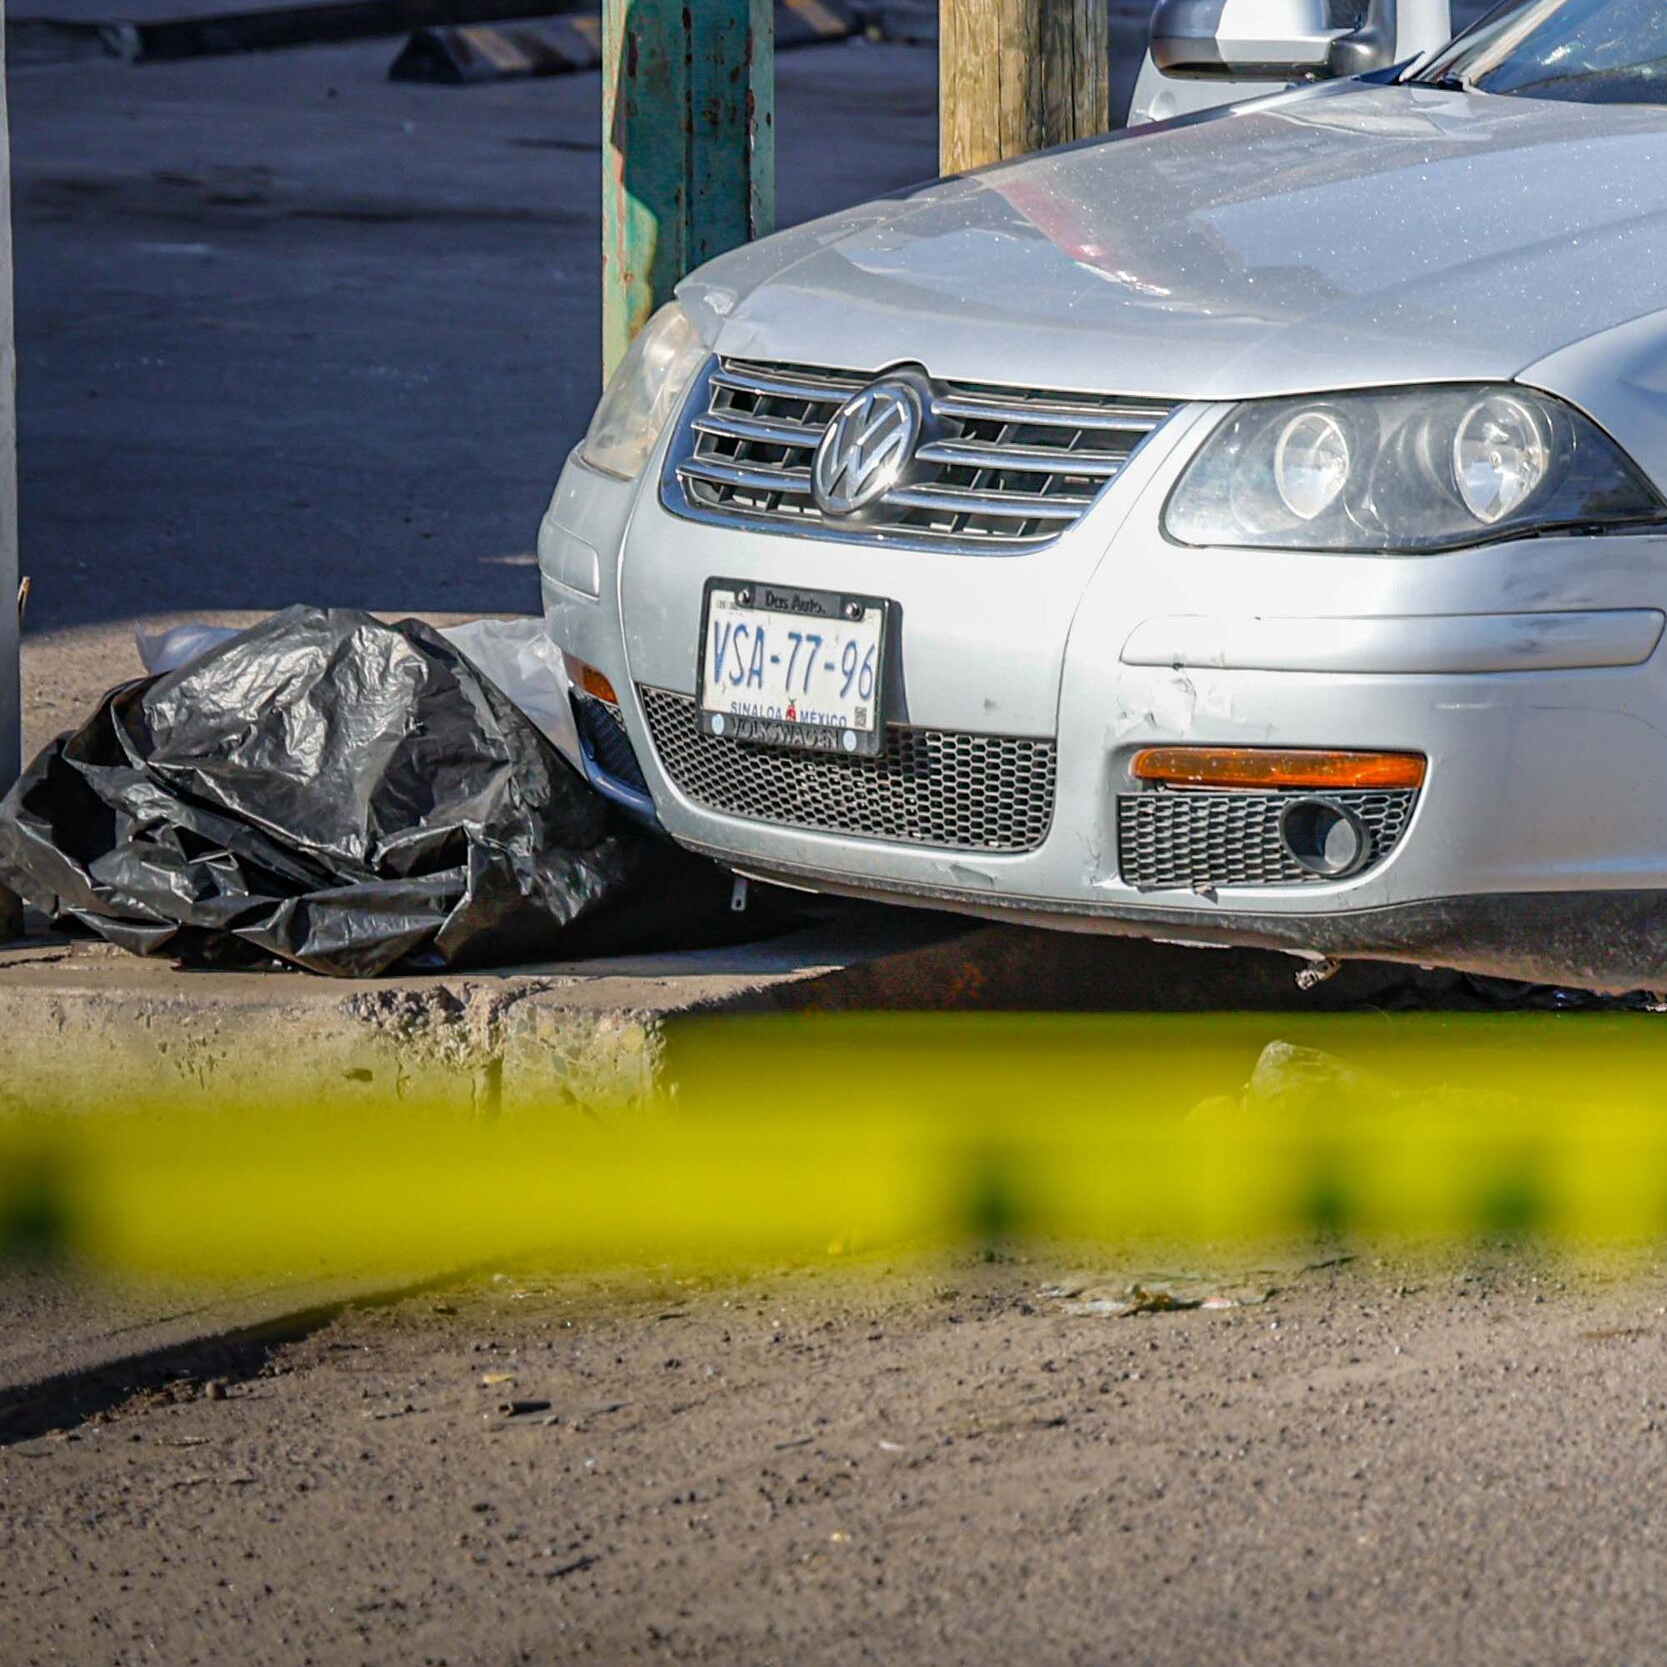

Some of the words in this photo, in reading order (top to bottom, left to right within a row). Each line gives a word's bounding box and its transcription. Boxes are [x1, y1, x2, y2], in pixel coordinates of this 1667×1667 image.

[765, 590, 789, 610] Das
[713, 620, 876, 701] VSA-77-96
[730, 701, 782, 720] SINALOA
[800, 709, 847, 727] MÉXICO
